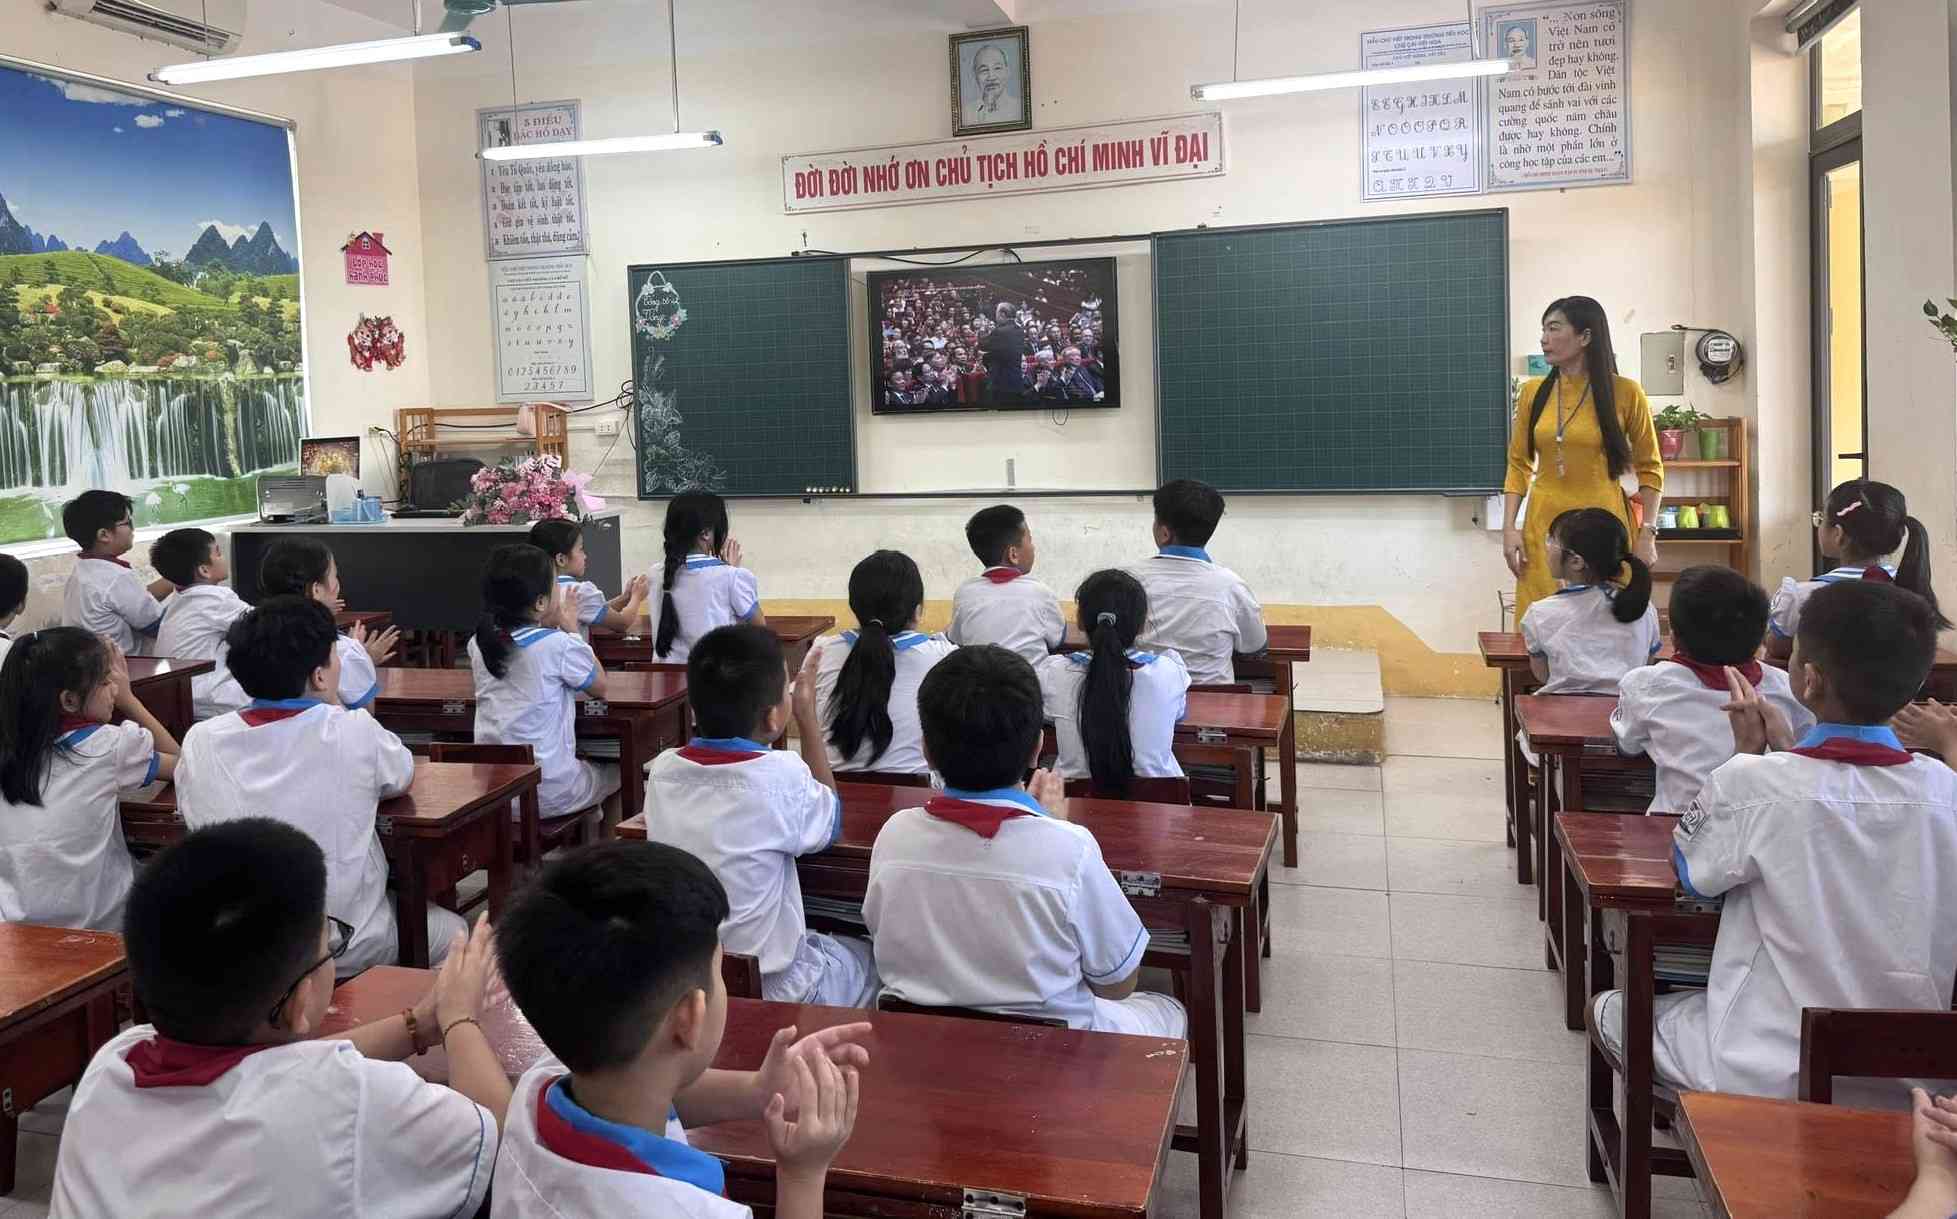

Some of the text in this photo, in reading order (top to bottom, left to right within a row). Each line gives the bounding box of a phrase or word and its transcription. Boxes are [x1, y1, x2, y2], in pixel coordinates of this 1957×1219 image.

[1548, 22, 1616, 37] Việt Nam có
[794, 130, 1210, 200] ĐỜI ĐỜI NHỚ ƠN CHỦ TỊCH HỒ CHÍ MINH VĨ ĐẠI
